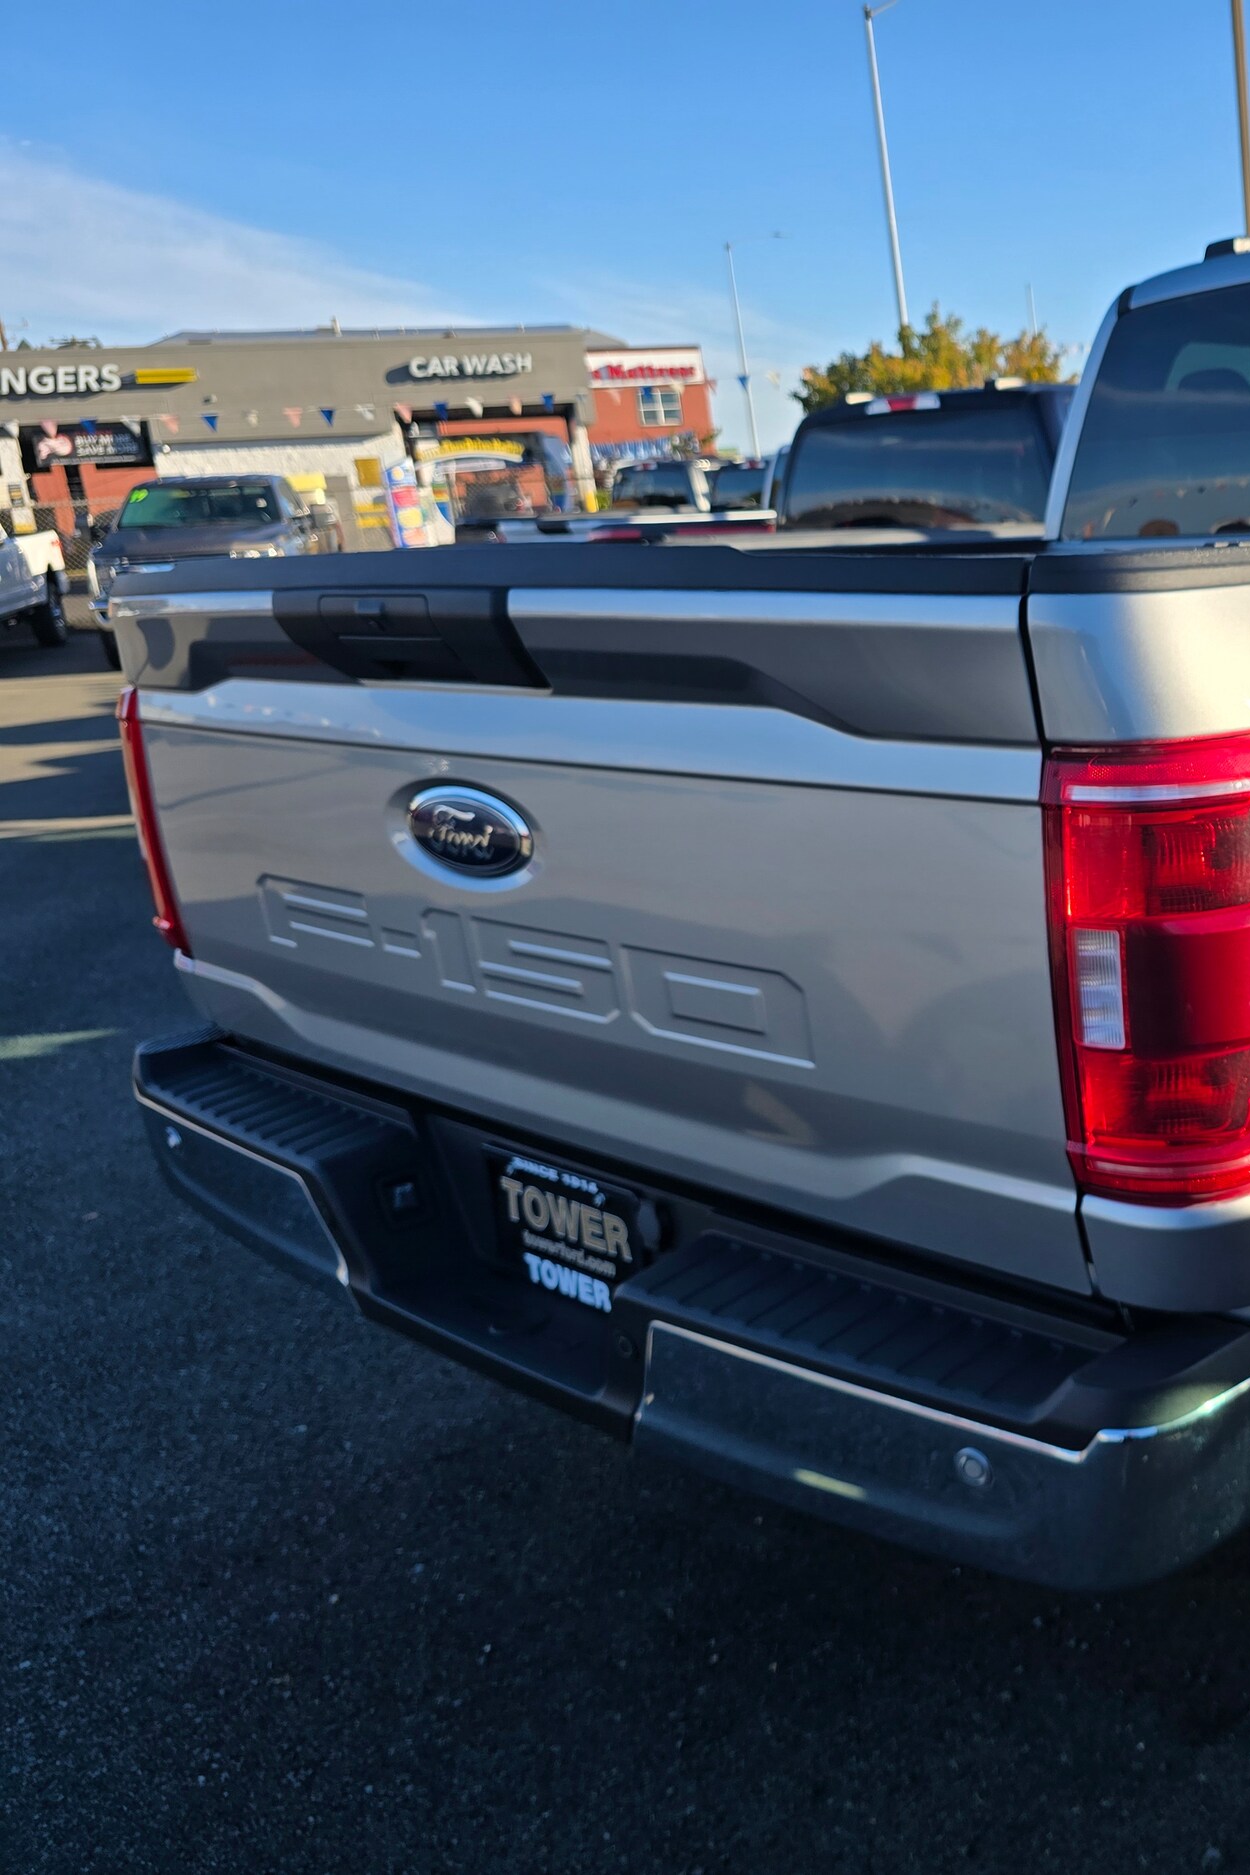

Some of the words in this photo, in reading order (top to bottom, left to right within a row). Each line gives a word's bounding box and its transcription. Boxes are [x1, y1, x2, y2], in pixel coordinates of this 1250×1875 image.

[0, 363, 122, 395] NGERS
[409, 355, 460, 378] CAR
[462, 351, 532, 376] WASH
[427, 803, 496, 860] Ford
[257, 872, 816, 1070] F-150
[500, 1175, 633, 1263] TOWER
[523, 1252, 612, 1313] TOWER
